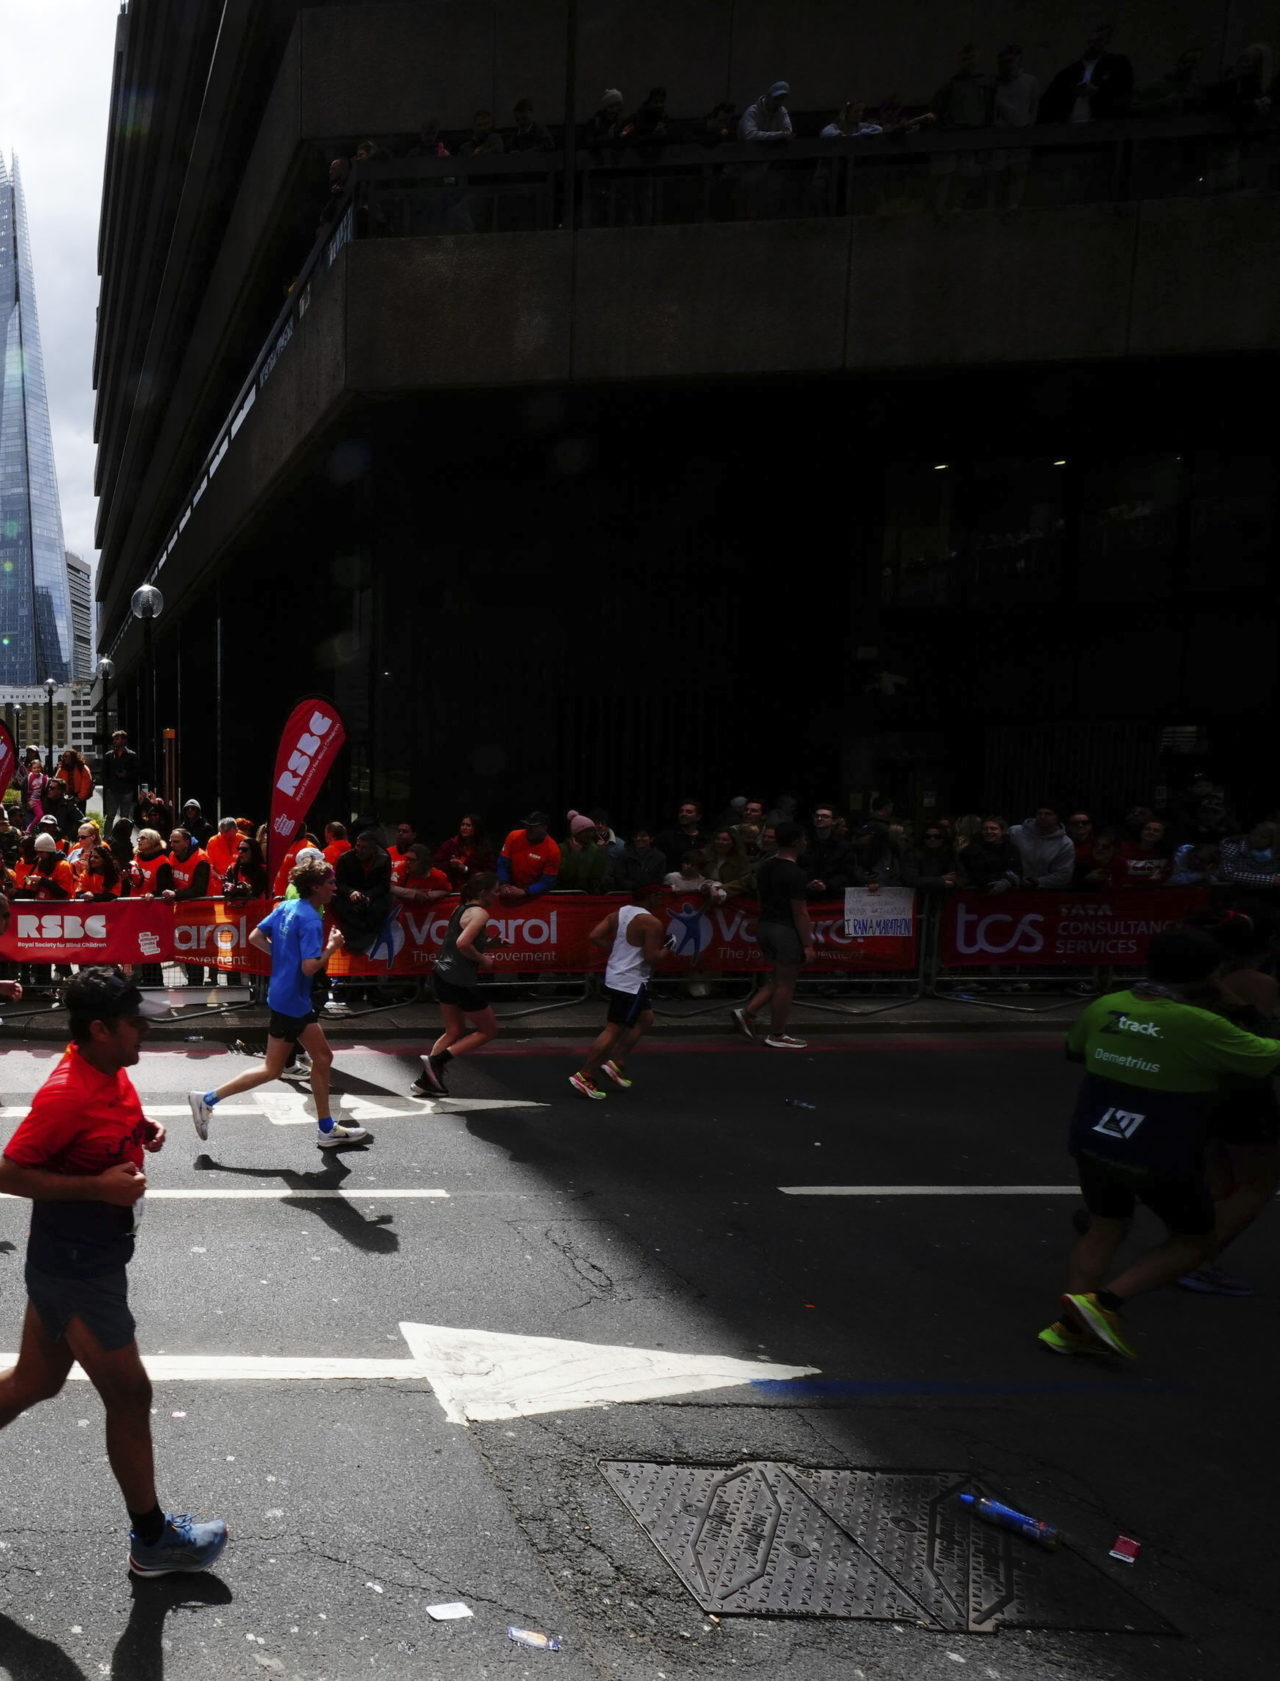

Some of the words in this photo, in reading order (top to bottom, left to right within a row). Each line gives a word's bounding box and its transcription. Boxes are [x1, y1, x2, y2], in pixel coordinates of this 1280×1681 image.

[276, 711, 332, 797] RSBC
[17, 914, 107, 939] RSBC
[174, 915, 247, 950] arol
[404, 910, 558, 945] Voarol
[955, 902, 1045, 954] tcs
[412, 951, 436, 962] The
[718, 948, 745, 960] The
[1055, 939, 1137, 954] SERVICES
[1095, 1048, 1160, 1072] Demetrius
